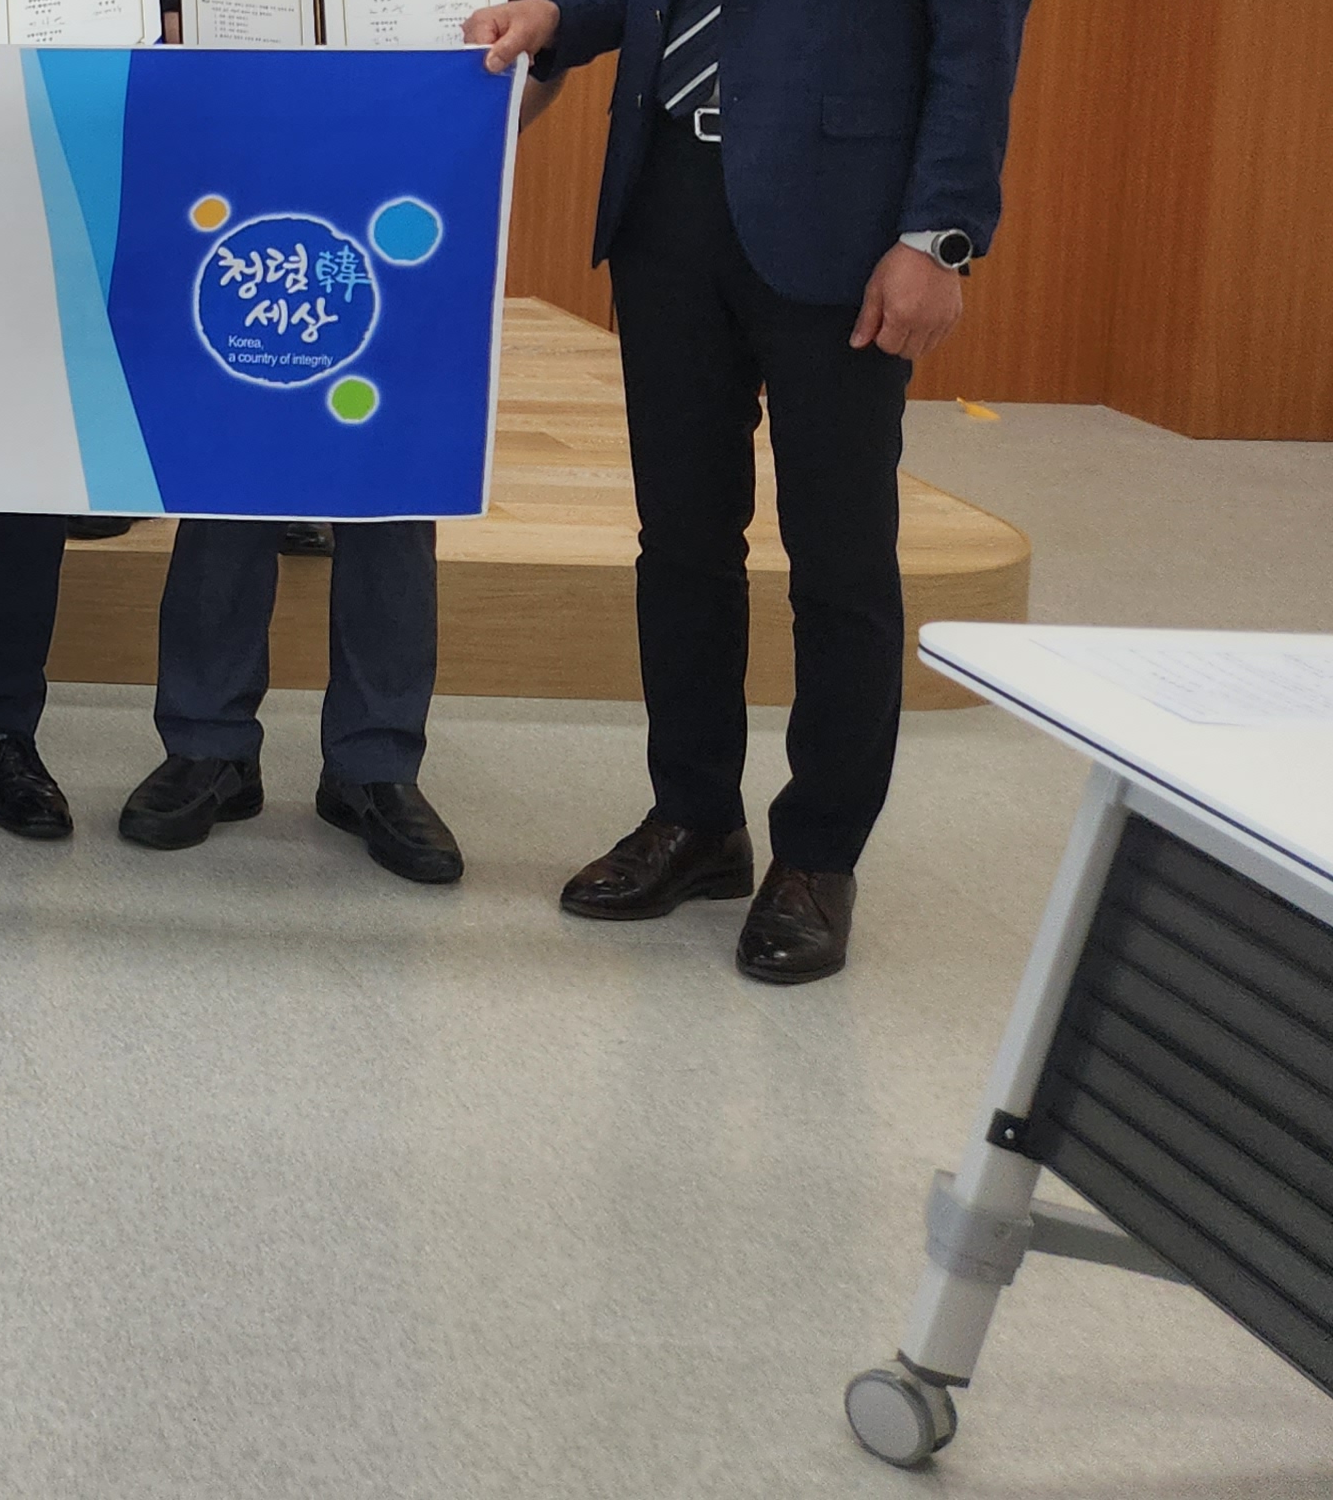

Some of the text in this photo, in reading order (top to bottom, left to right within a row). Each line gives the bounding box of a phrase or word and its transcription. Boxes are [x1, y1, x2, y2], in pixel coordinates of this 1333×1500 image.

[244, 297, 338, 343] 세상
[228, 335, 264, 350] Korea,
[228, 352, 333, 368] a country of integrity
